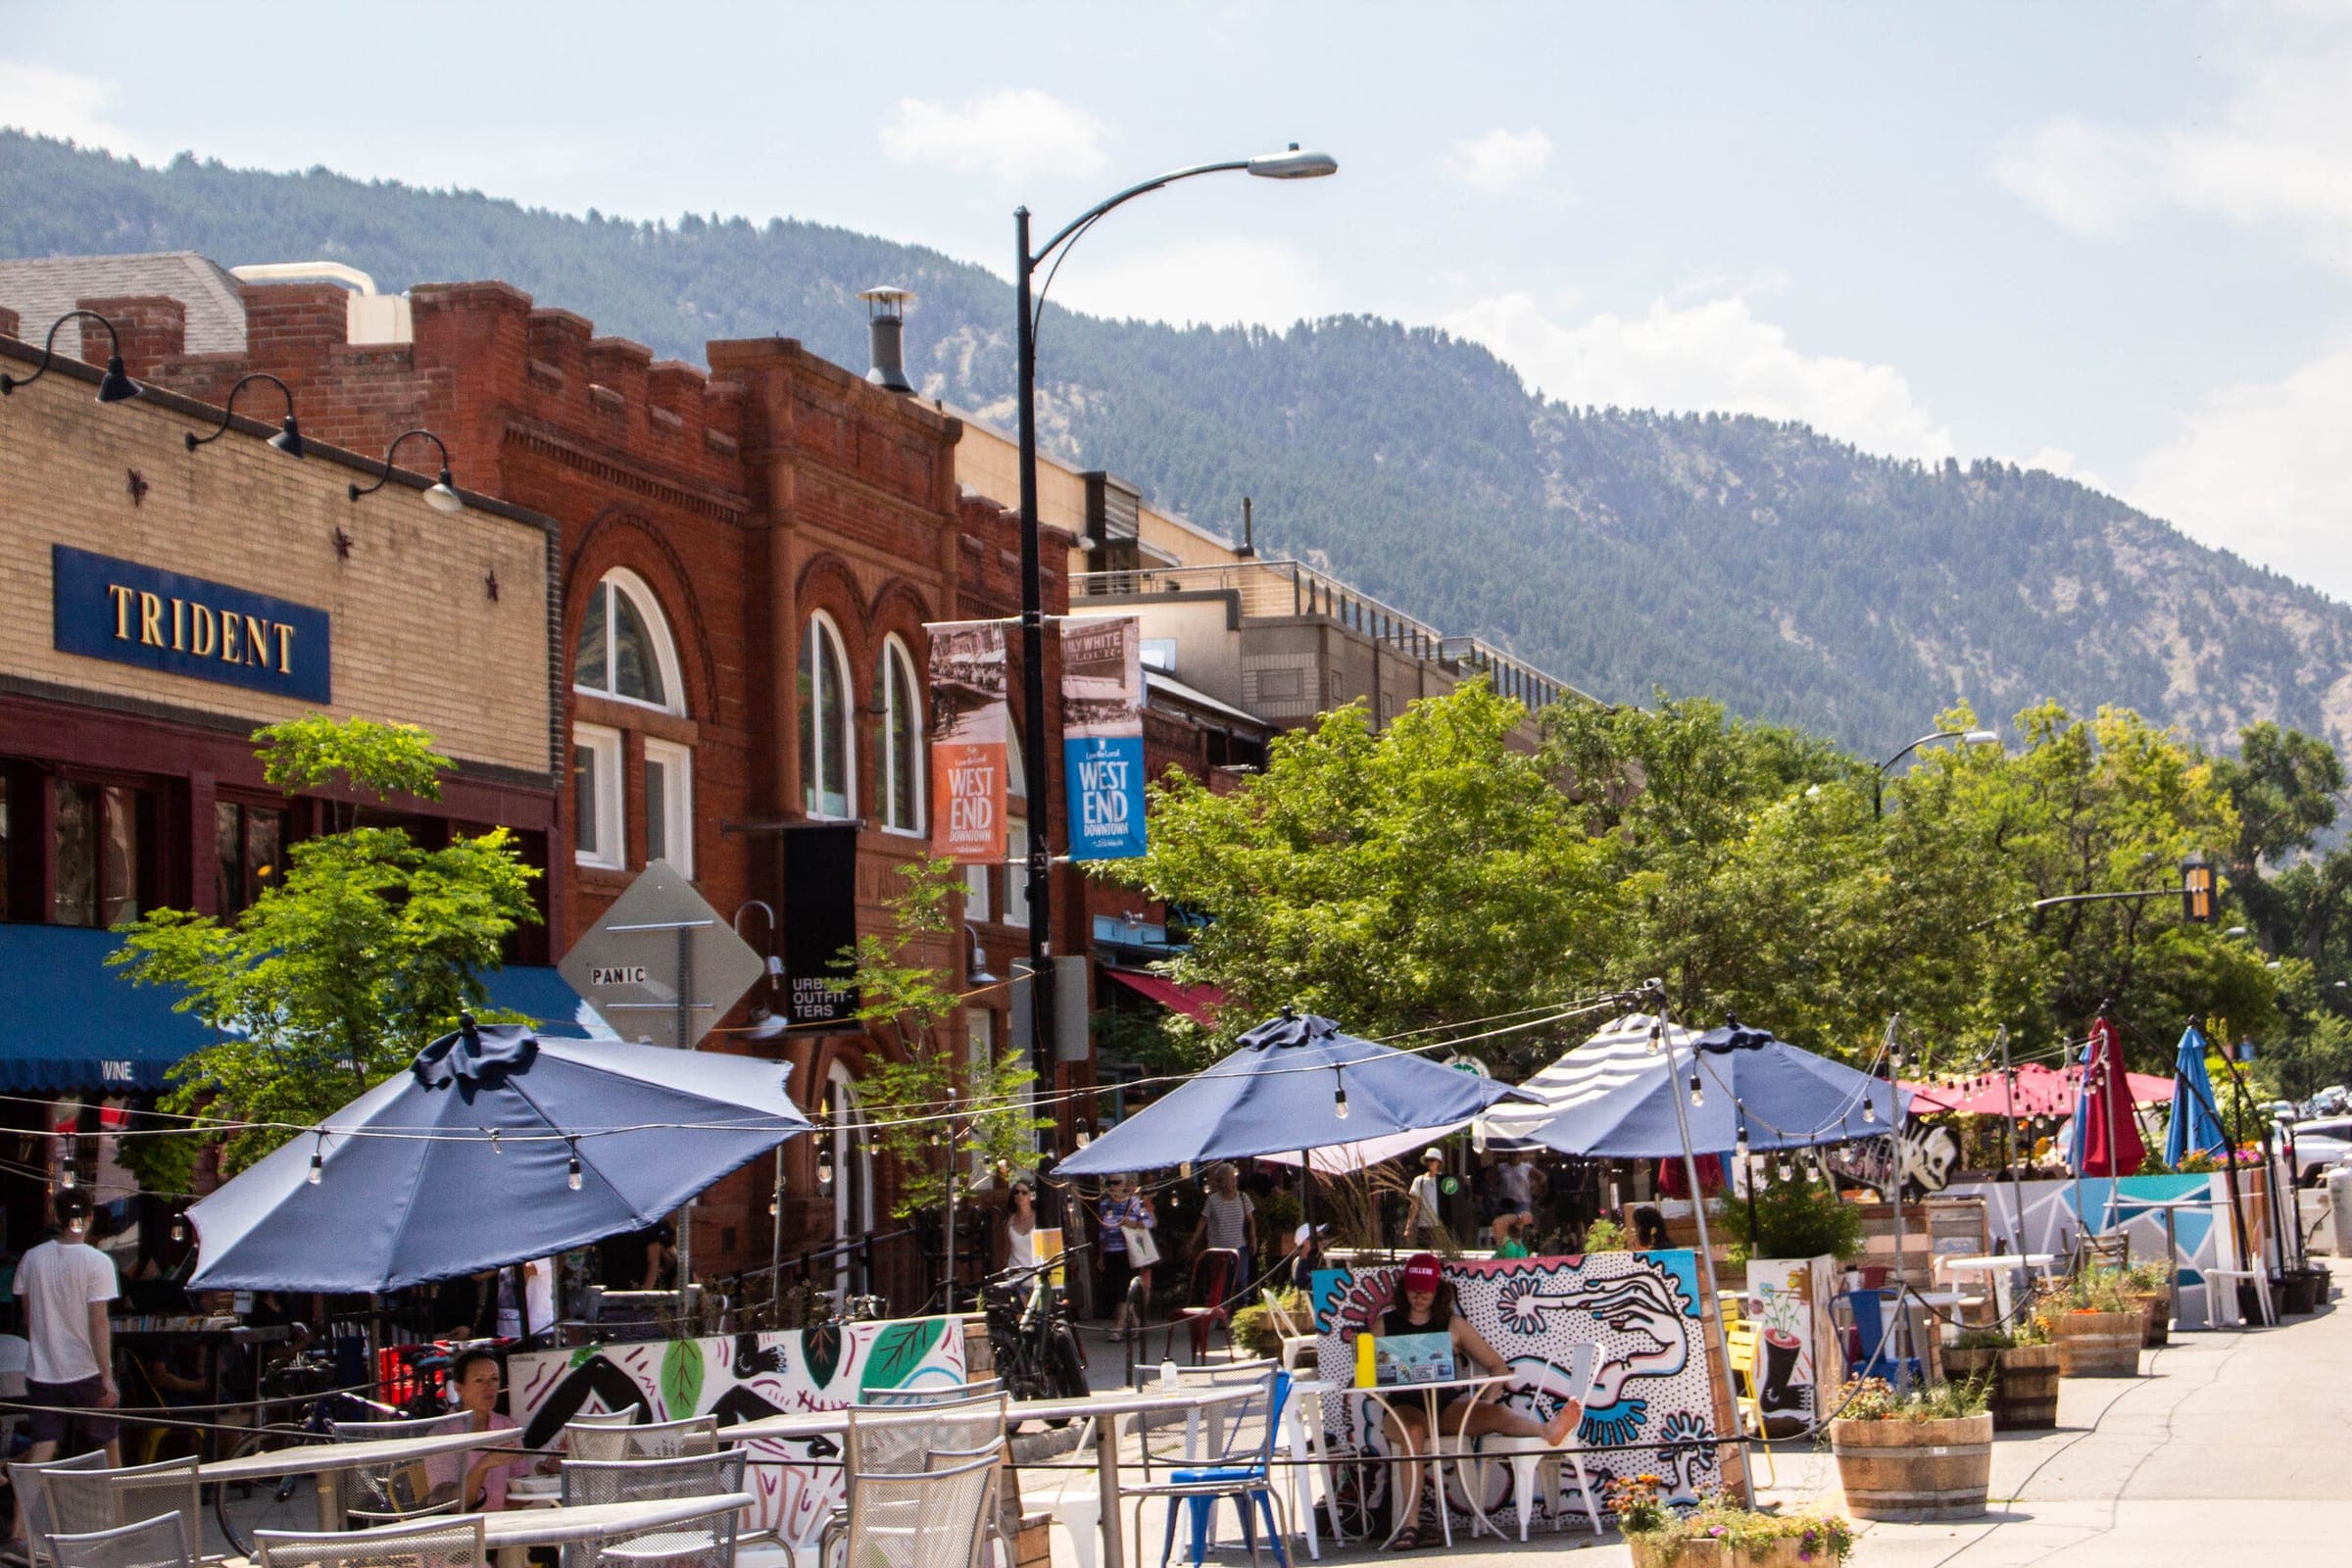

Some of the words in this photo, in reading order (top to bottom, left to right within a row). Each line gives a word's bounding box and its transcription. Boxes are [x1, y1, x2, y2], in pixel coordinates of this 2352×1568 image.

[109, 584, 294, 674] TRIDENT
[1083, 631, 1121, 652] WHITE
[948, 767, 994, 797] WEST
[1078, 760, 1129, 791] WEST
[951, 796, 993, 830] END
[1082, 790, 1128, 823] END
[949, 829, 991, 843] DOWNTOWN
[1084, 822, 1129, 837] DOWNTOWN
[592, 967, 645, 985] PANIC
[792, 977, 847, 991] URB
[792, 990, 854, 1004] OUTFIT-
[794, 1004, 833, 1018] TERS
[101, 1060, 132, 1081] WINE
